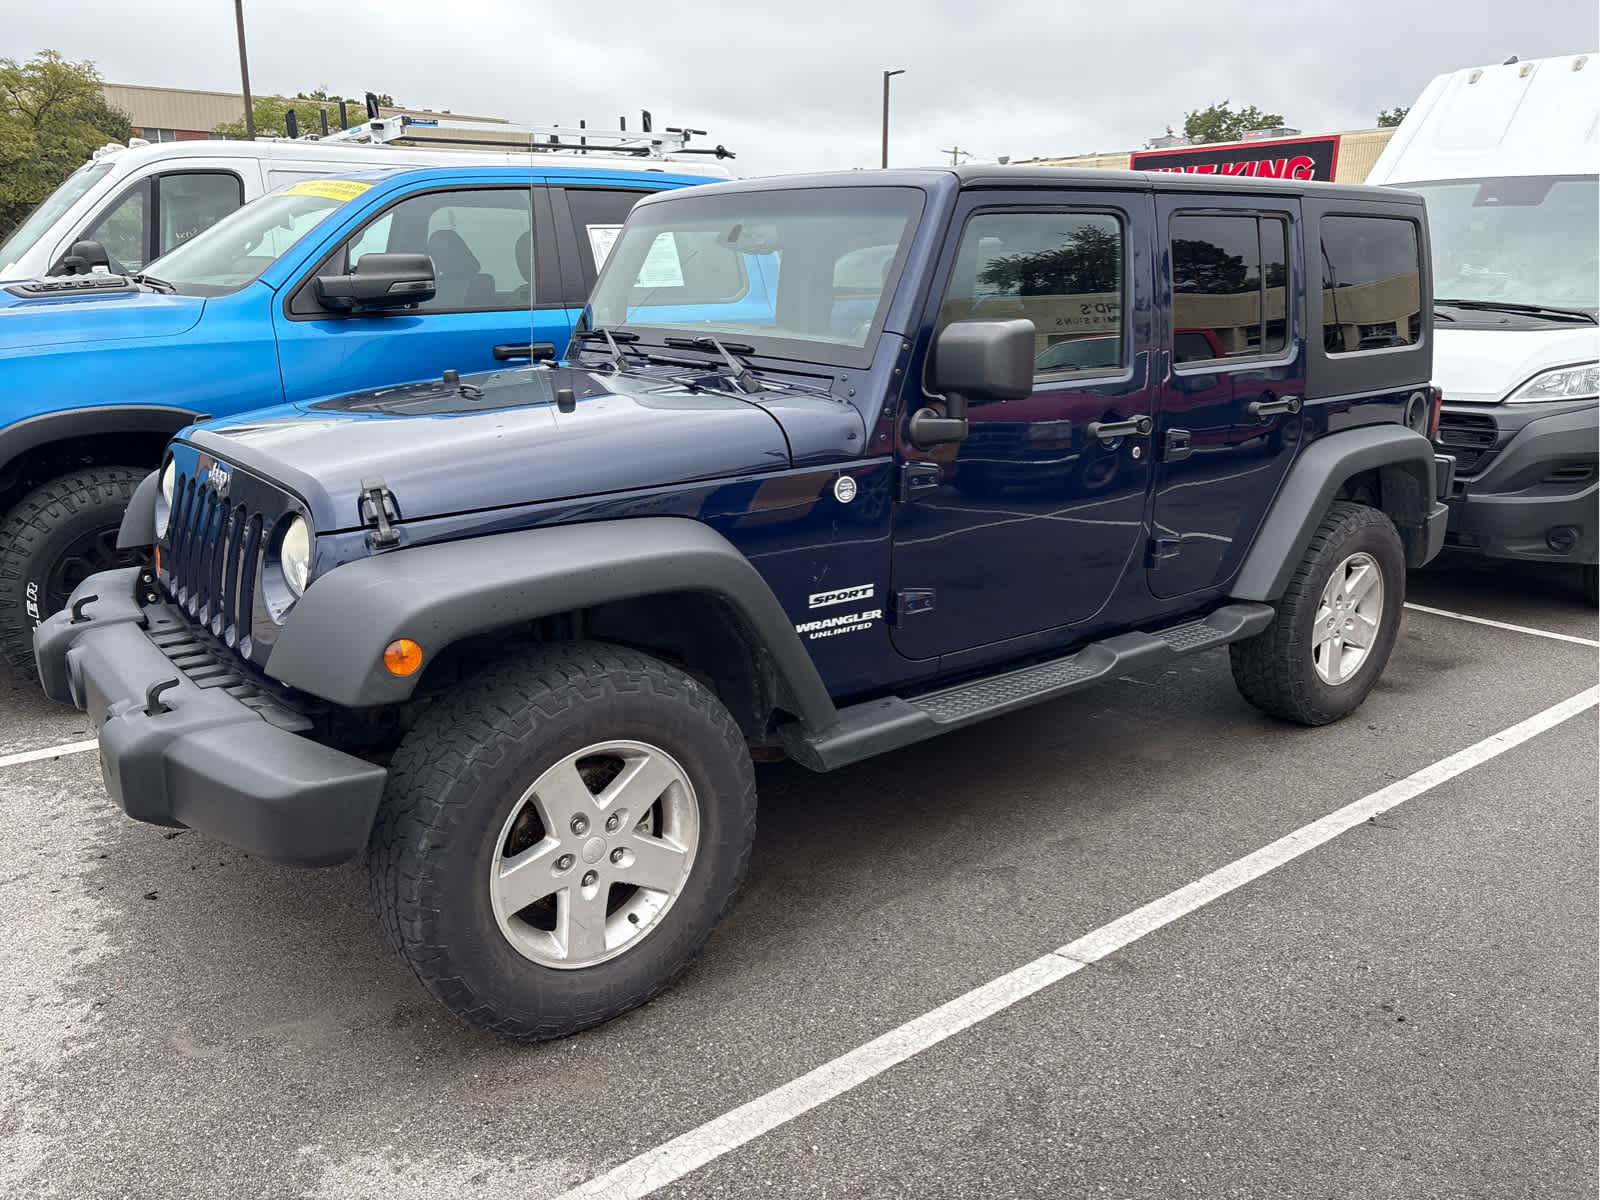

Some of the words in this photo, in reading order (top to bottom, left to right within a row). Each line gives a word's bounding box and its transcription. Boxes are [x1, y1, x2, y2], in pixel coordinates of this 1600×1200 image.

[810, 587, 870, 605] SPORT
[795, 609, 882, 633] WRANGLER
[809, 622, 873, 640] UNLIMITED
